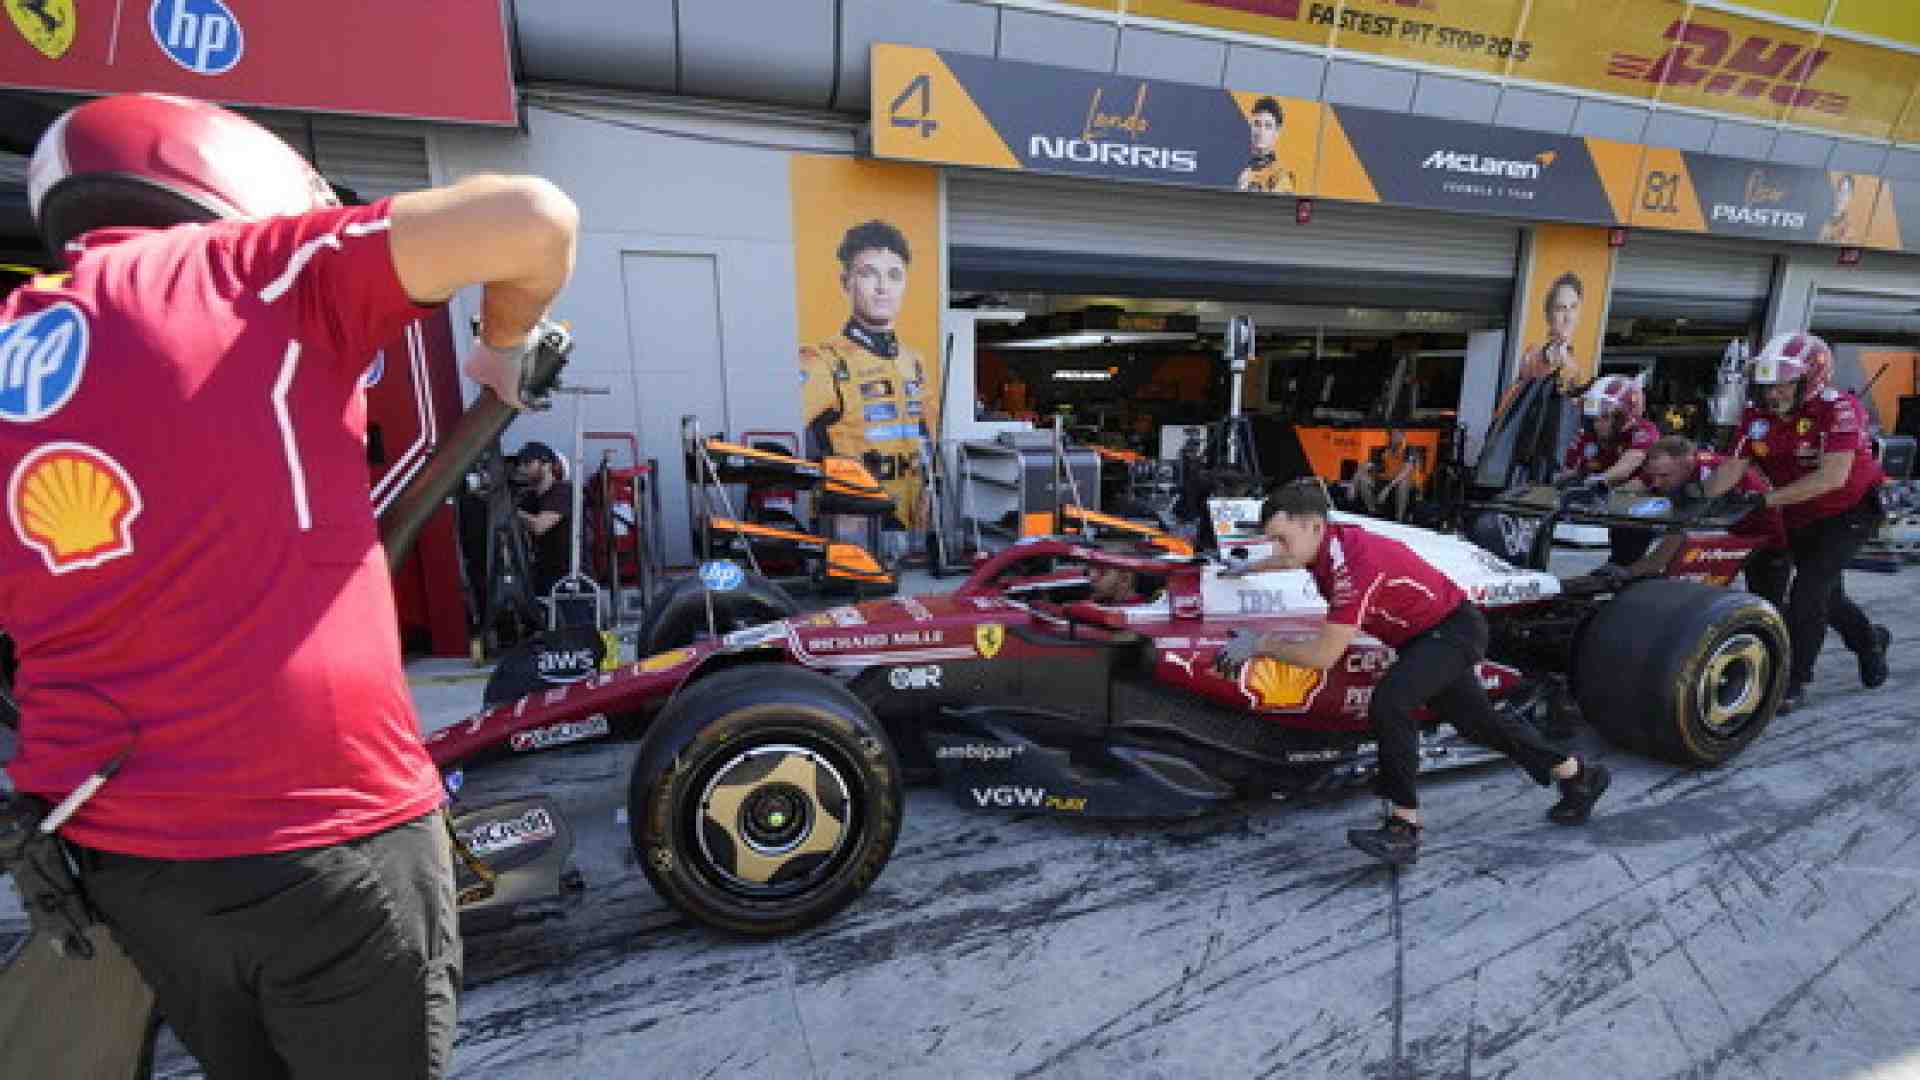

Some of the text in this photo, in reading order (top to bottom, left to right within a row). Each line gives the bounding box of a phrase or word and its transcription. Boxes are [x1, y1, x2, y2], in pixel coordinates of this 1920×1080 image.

[167, 0, 227, 72] hp
[1309, 3, 1400, 38] FASTEST
[1401, 20, 1436, 43] PIT
[1438, 26, 1486, 50] STOP
[1645, 20, 1834, 107] DHL
[890, 74, 938, 138] 4
[1029, 134, 1198, 173] NORRIS
[1421, 150, 1538, 180] McLaren
[1641, 170, 1682, 213] 81
[1711, 203, 1807, 229] PIASTRI
[0, 316, 73, 415] hp
[1237, 588, 1286, 613] IBM
[808, 630, 944, 650] RICHARD MILLE
[537, 648, 595, 673] aws
[970, 787, 1046, 807] VGW
